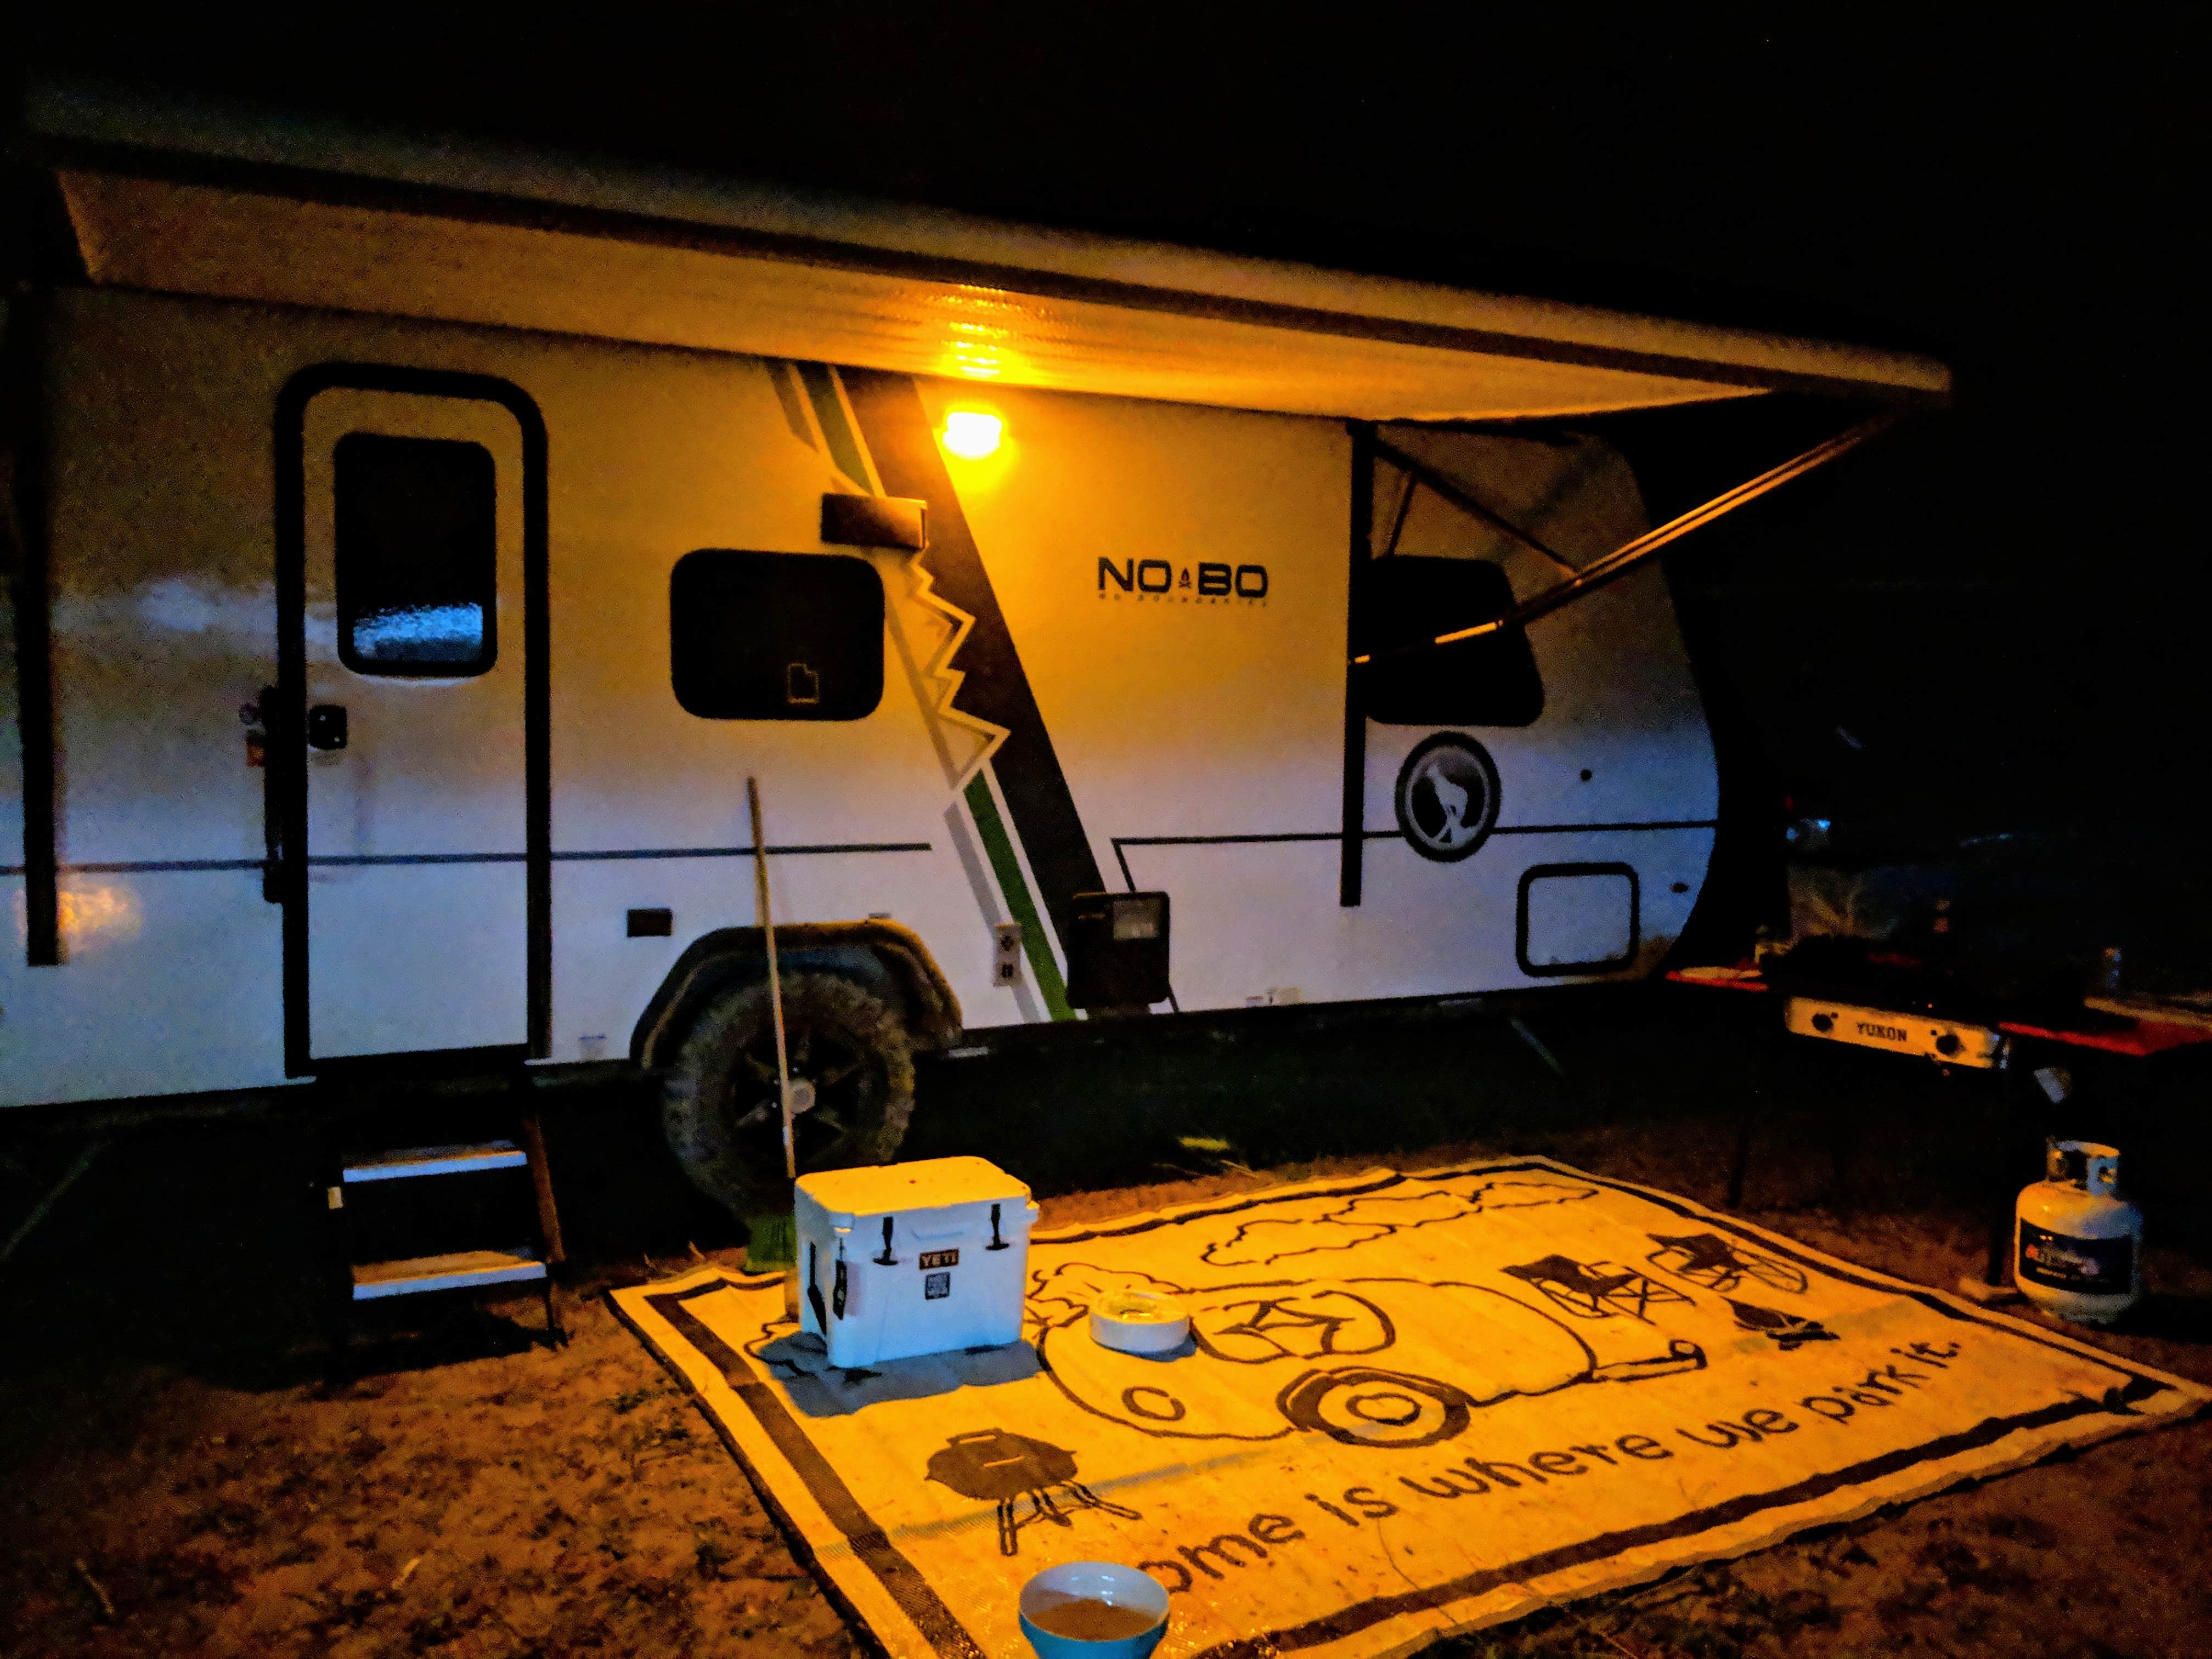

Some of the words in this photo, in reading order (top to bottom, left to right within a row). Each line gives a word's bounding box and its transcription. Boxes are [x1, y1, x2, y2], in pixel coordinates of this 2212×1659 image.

[1857, 1022, 1907, 1042] YUKON
[921, 1251, 956, 1266] YETI
[1137, 1513, 1305, 1595] ome
[1398, 1434, 1674, 1499] where
[1675, 1408, 1799, 1449] we
[1794, 1364, 1931, 1425] park
